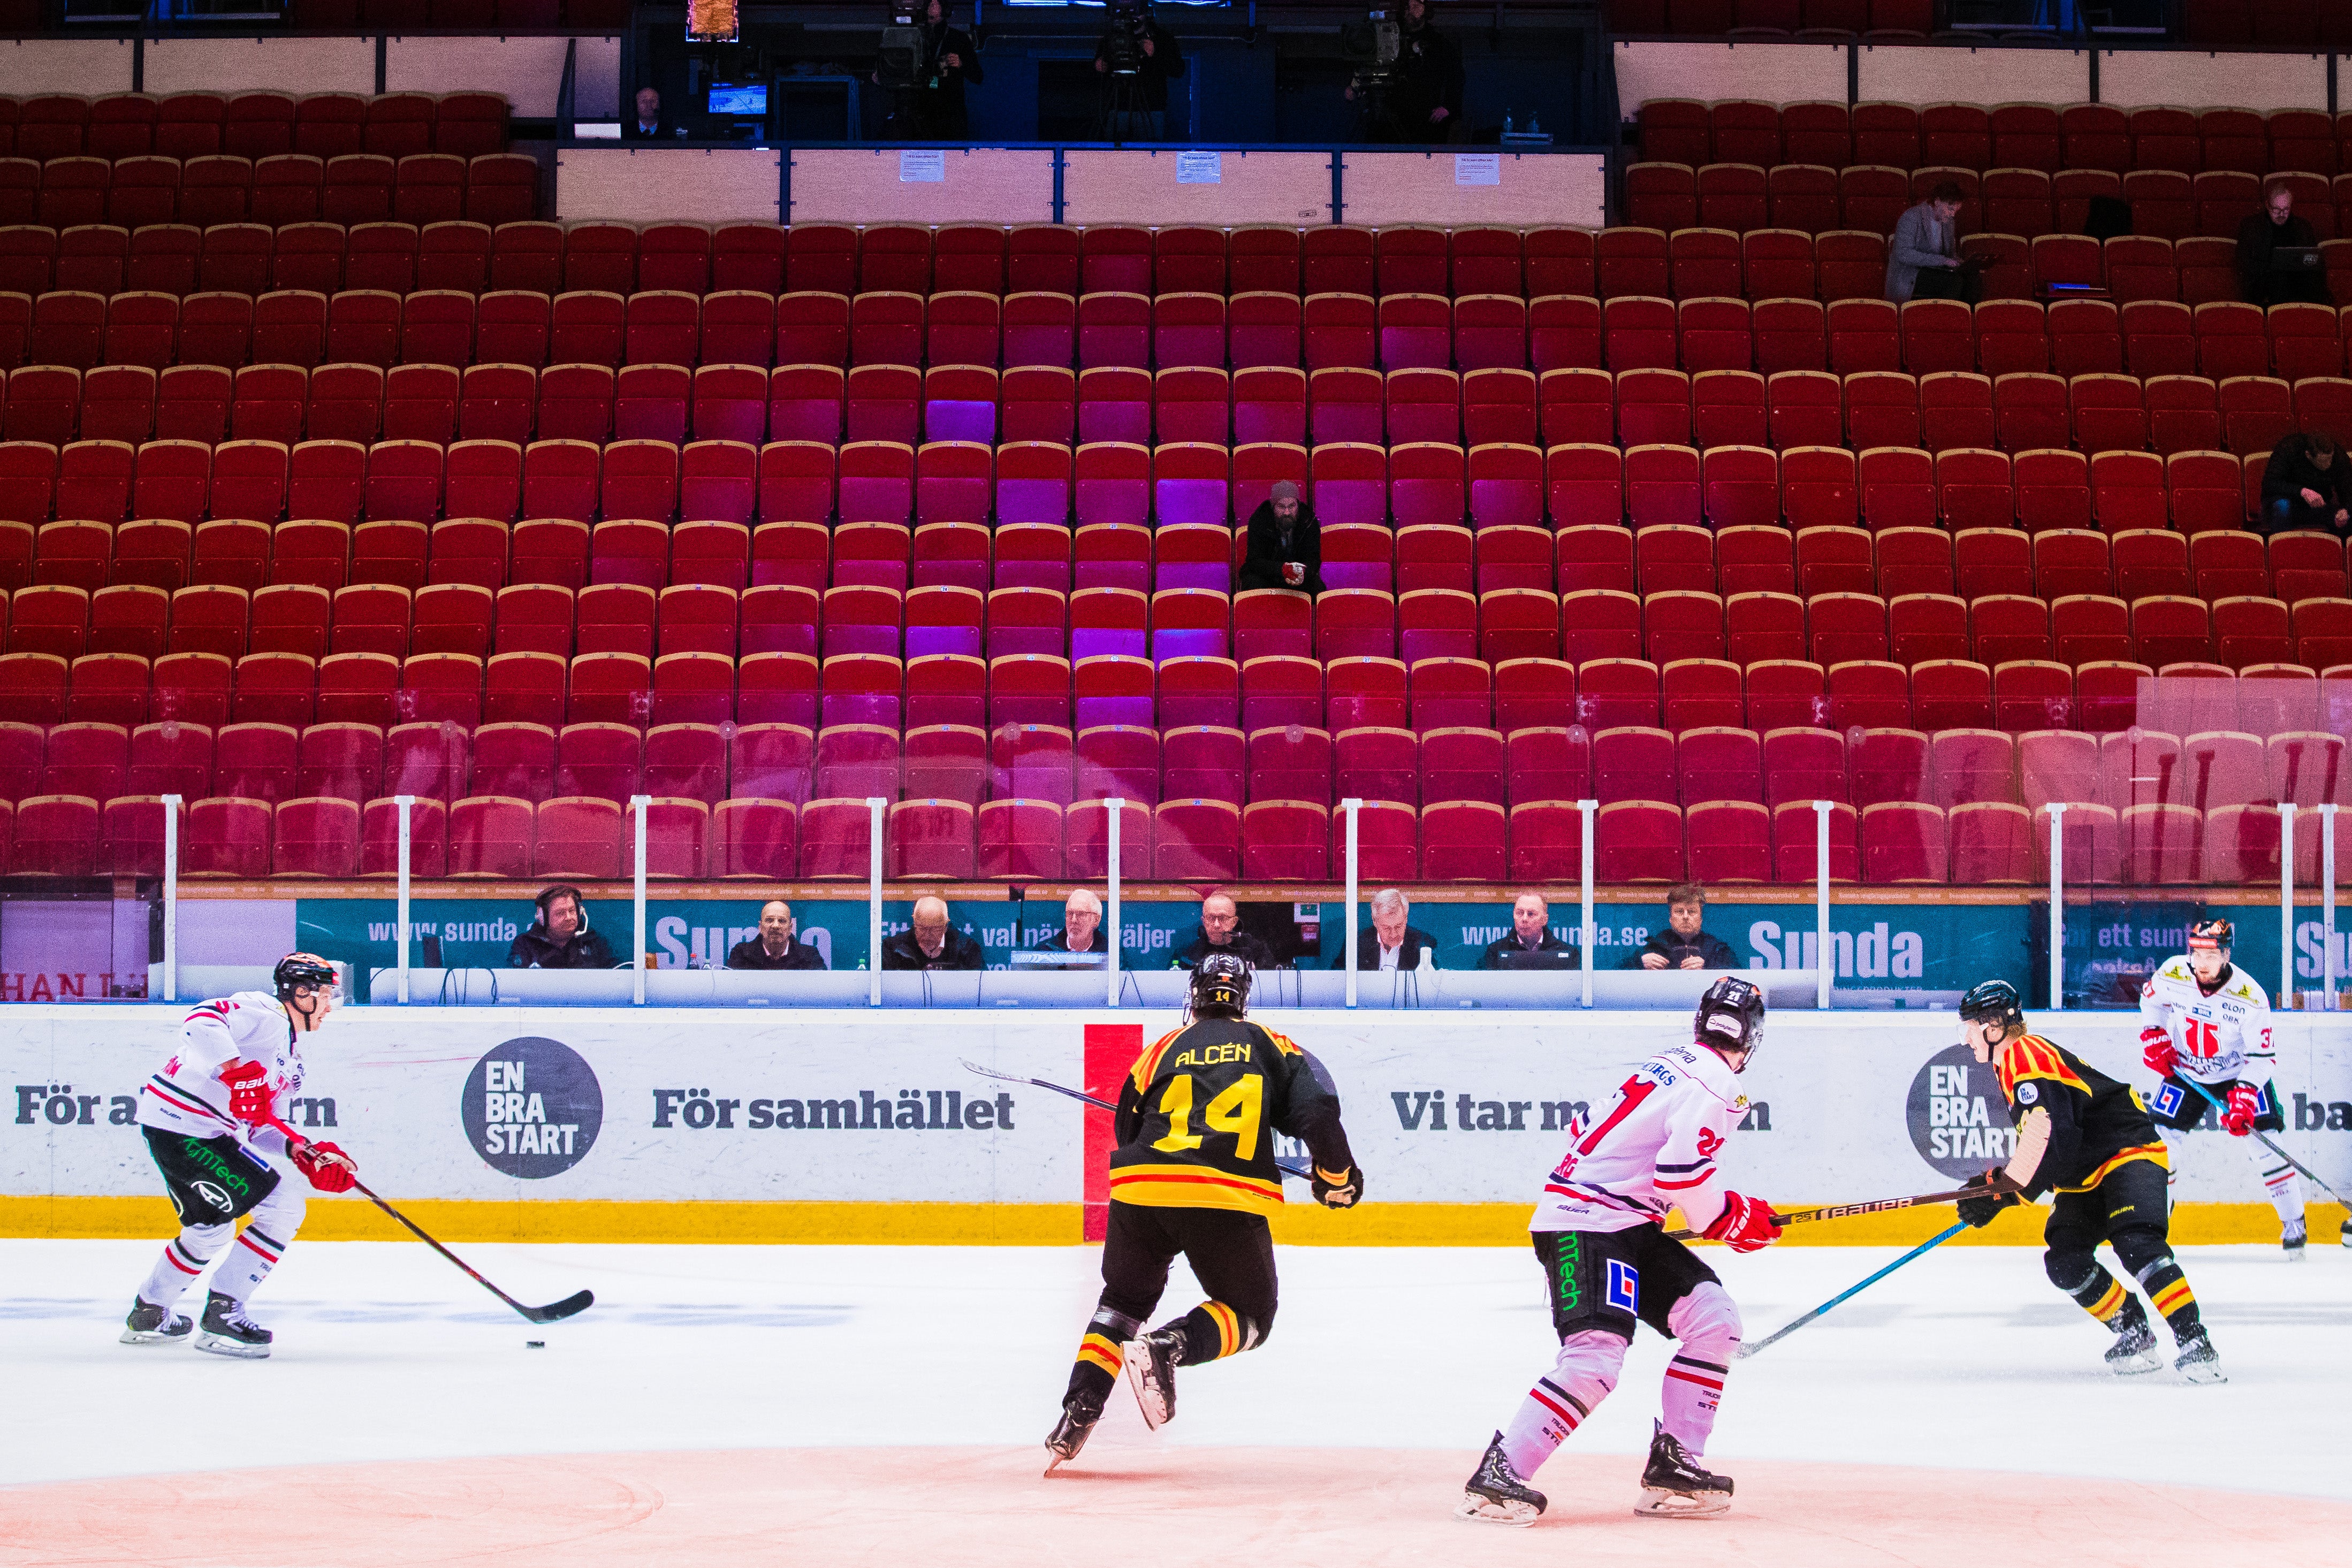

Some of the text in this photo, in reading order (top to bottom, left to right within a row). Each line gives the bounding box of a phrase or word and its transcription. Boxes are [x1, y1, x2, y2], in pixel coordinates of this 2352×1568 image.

[1119, 923, 1176, 954] äljer
[2098, 923, 2132, 947] ett
[1215, 991, 1230, 1002] 14
[1727, 991, 1741, 1001] 21
[2222, 1002, 2246, 1015] elon
[1175, 1042, 1251, 1068] ALCÉN
[486, 1061, 524, 1092] EN
[1930, 1065, 1968, 1096] EN
[15, 1084, 101, 1125] För
[486, 1092, 547, 1123] BRA
[652, 1087, 1015, 1130] För samhället
[1150, 1073, 1263, 1161] 14
[1391, 1090, 1448, 1131] Vi
[1456, 1093, 1532, 1131] tar
[1930, 1096, 1990, 1127] BRA
[486, 1123, 579, 1155] START
[1930, 1127, 2018, 1159] START
[1557, 1205, 1589, 1215] BAUER
[1795, 1197, 1914, 1223] 25 BAUER
